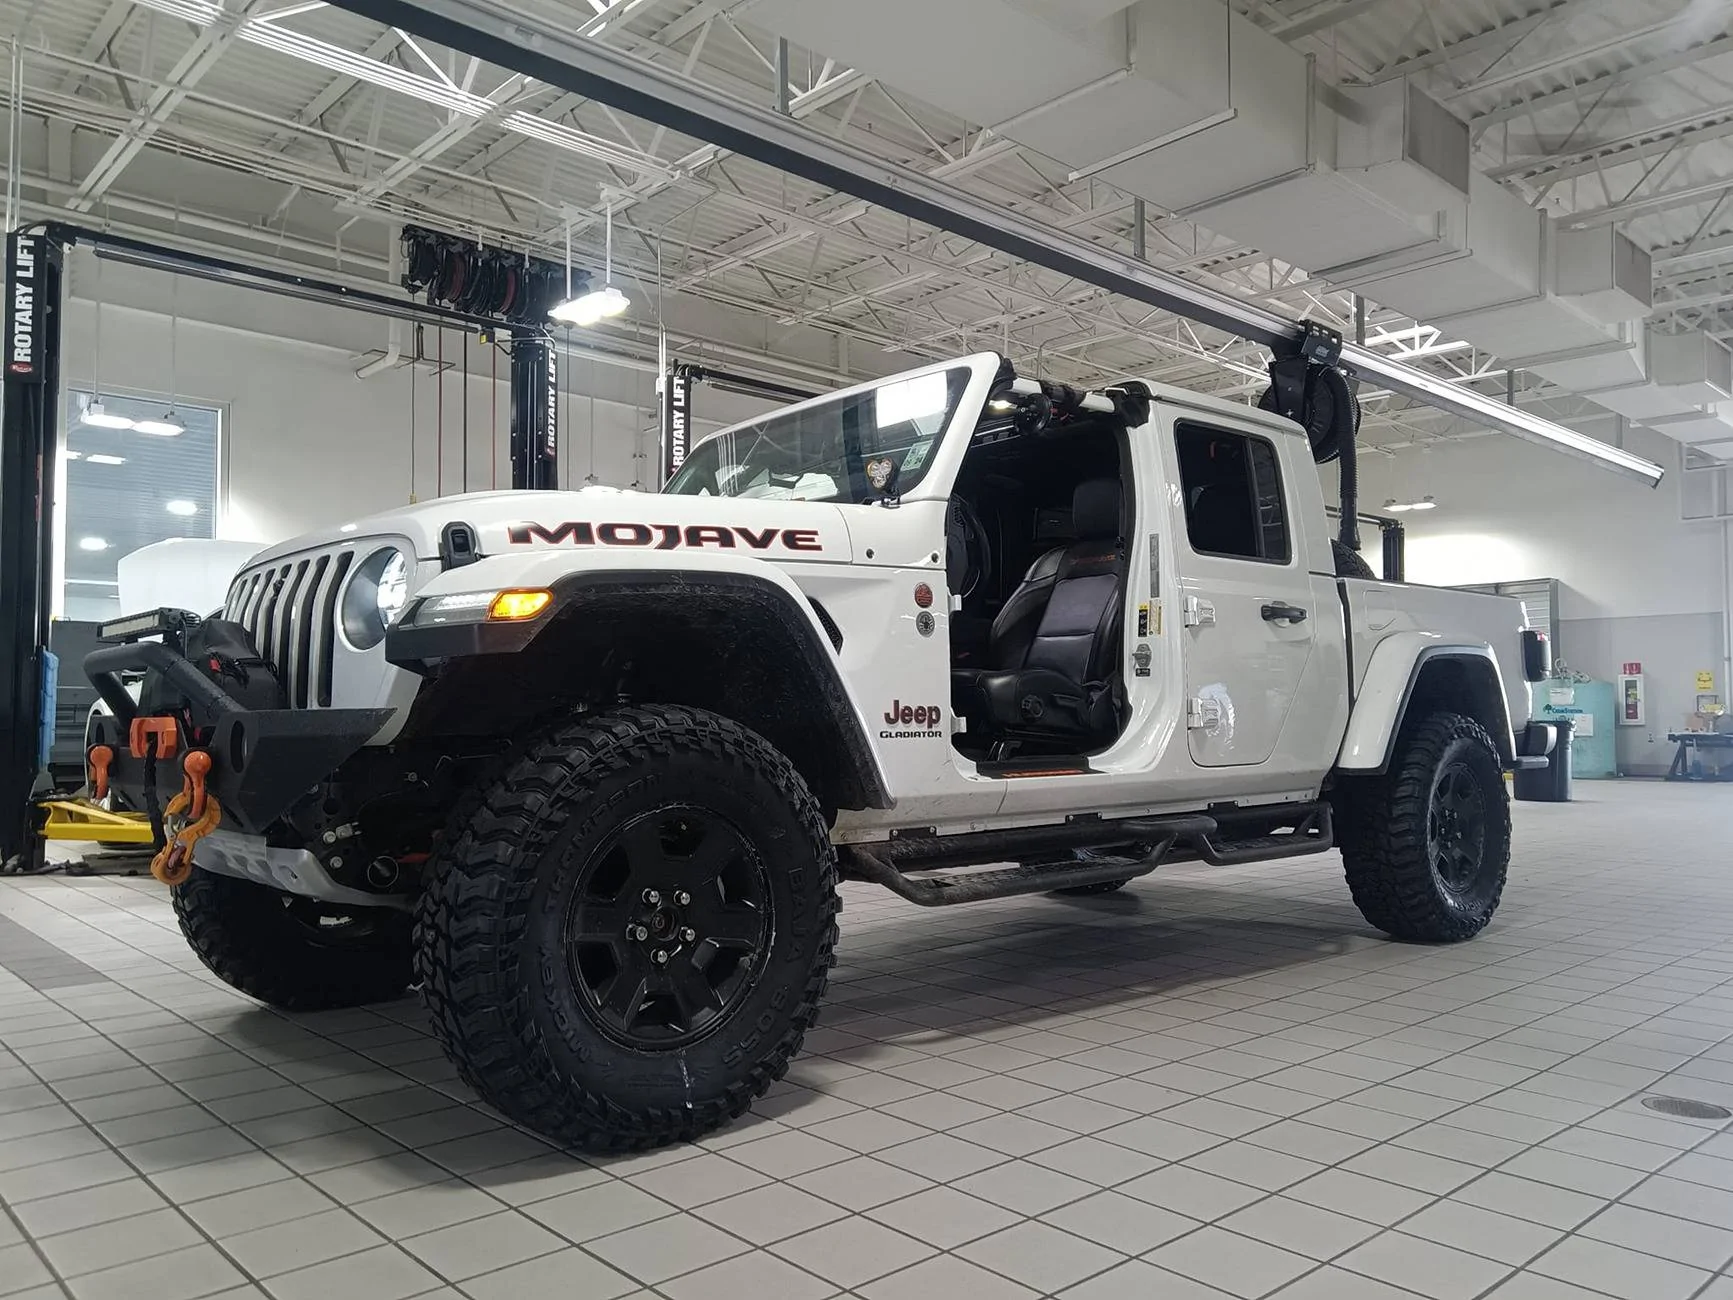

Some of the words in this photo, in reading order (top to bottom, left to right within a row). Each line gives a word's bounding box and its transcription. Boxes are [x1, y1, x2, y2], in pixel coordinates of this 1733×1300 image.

[17, 236, 35, 279] LIFT
[14, 282, 33, 362] ROTARY
[548, 349, 557, 383] LIFT
[673, 376, 685, 407] LIFT
[547, 385, 556, 447] ROTARY
[673, 409, 685, 466] ROTARY
[509, 522, 823, 550] MOJAVE
[884, 700, 942, 729] Jeep
[880, 730, 942, 739] GLADIATOR
[722, 988, 788, 1067] BOSS
